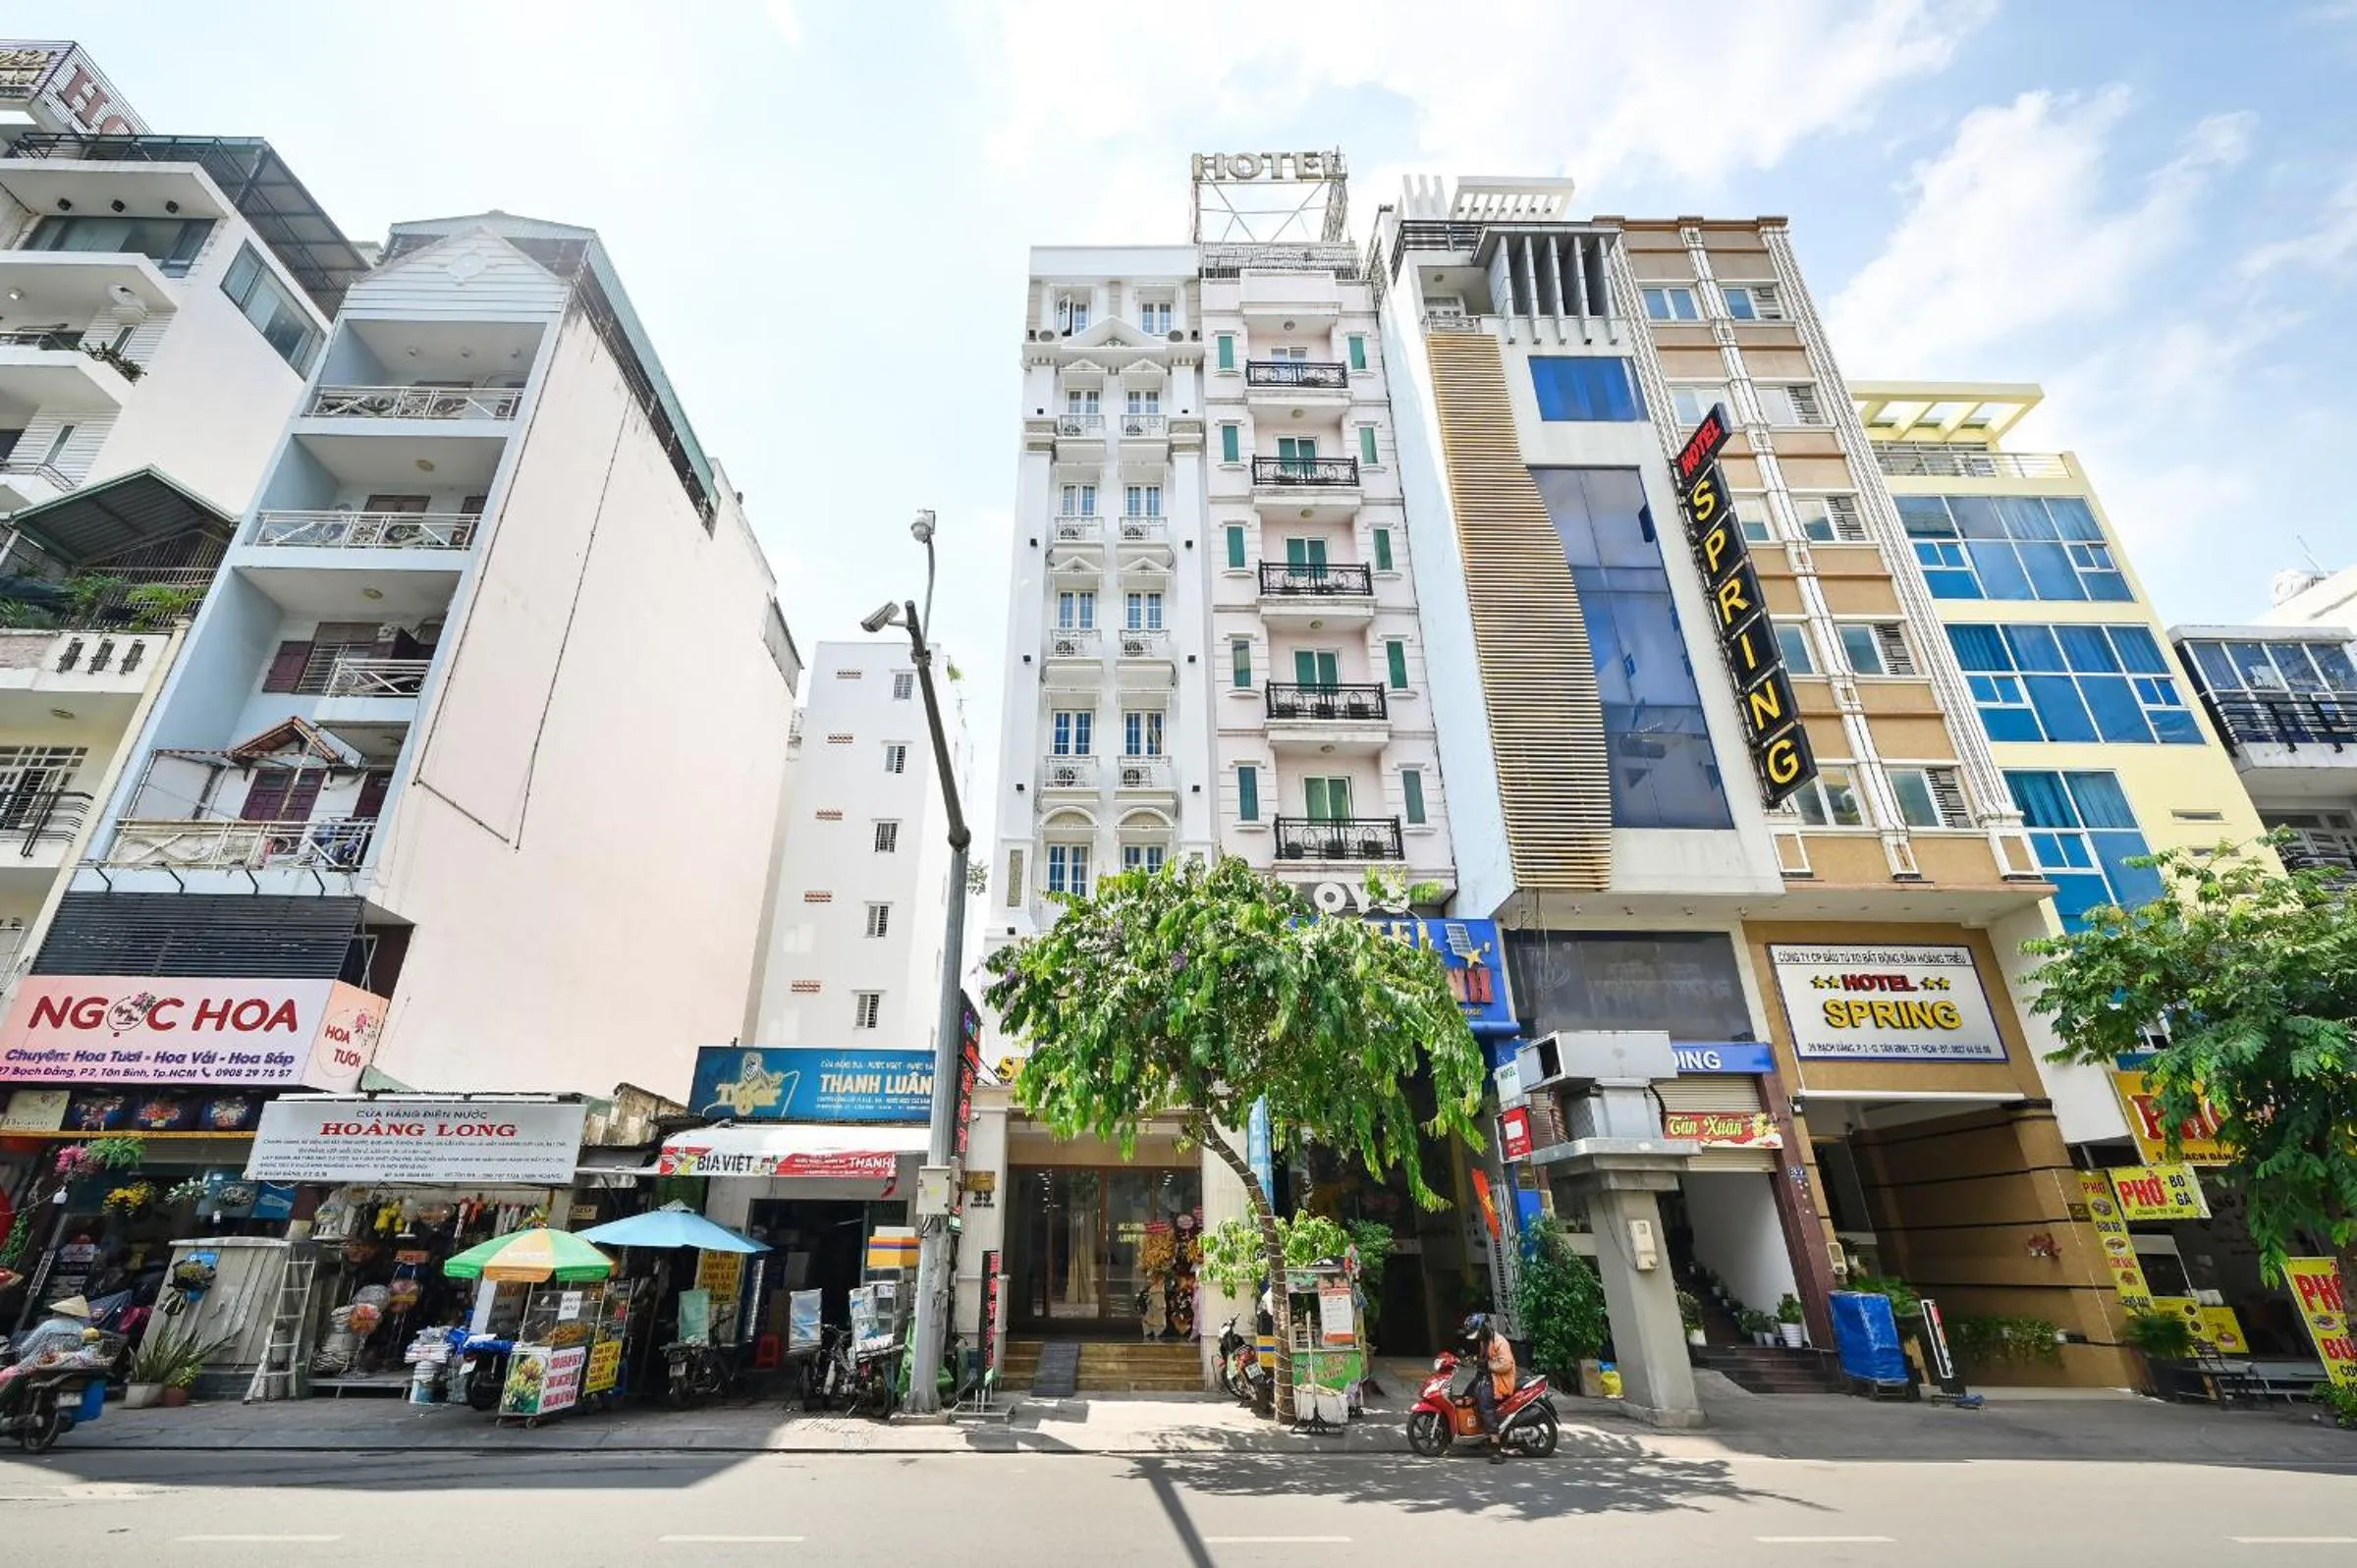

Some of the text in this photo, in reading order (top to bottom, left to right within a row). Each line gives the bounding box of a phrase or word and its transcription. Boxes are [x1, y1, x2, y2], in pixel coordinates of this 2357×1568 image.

[1191, 151, 1348, 181] HOTEL
[1680, 417, 1722, 478] HOTEL
[1691, 480, 1800, 784] SPRING
[1842, 974, 1918, 992] HOTEL
[192, 998, 299, 1032] HOA
[1824, 999, 1962, 1030] SPRING
[325, 1024, 350, 1045] HOA
[5, 1049, 71, 1064] Chuyên:
[73, 1050, 107, 1062] Hoa
[154, 1051, 188, 1063] Hoa
[228, 1052, 261, 1064] Hoa
[820, 1071, 933, 1095] THANH LUÂN
[319, 1118, 518, 1137] HOÀNG LONG
[697, 1153, 754, 1173] BIA VIỆT
[849, 1157, 892, 1168] THANH
